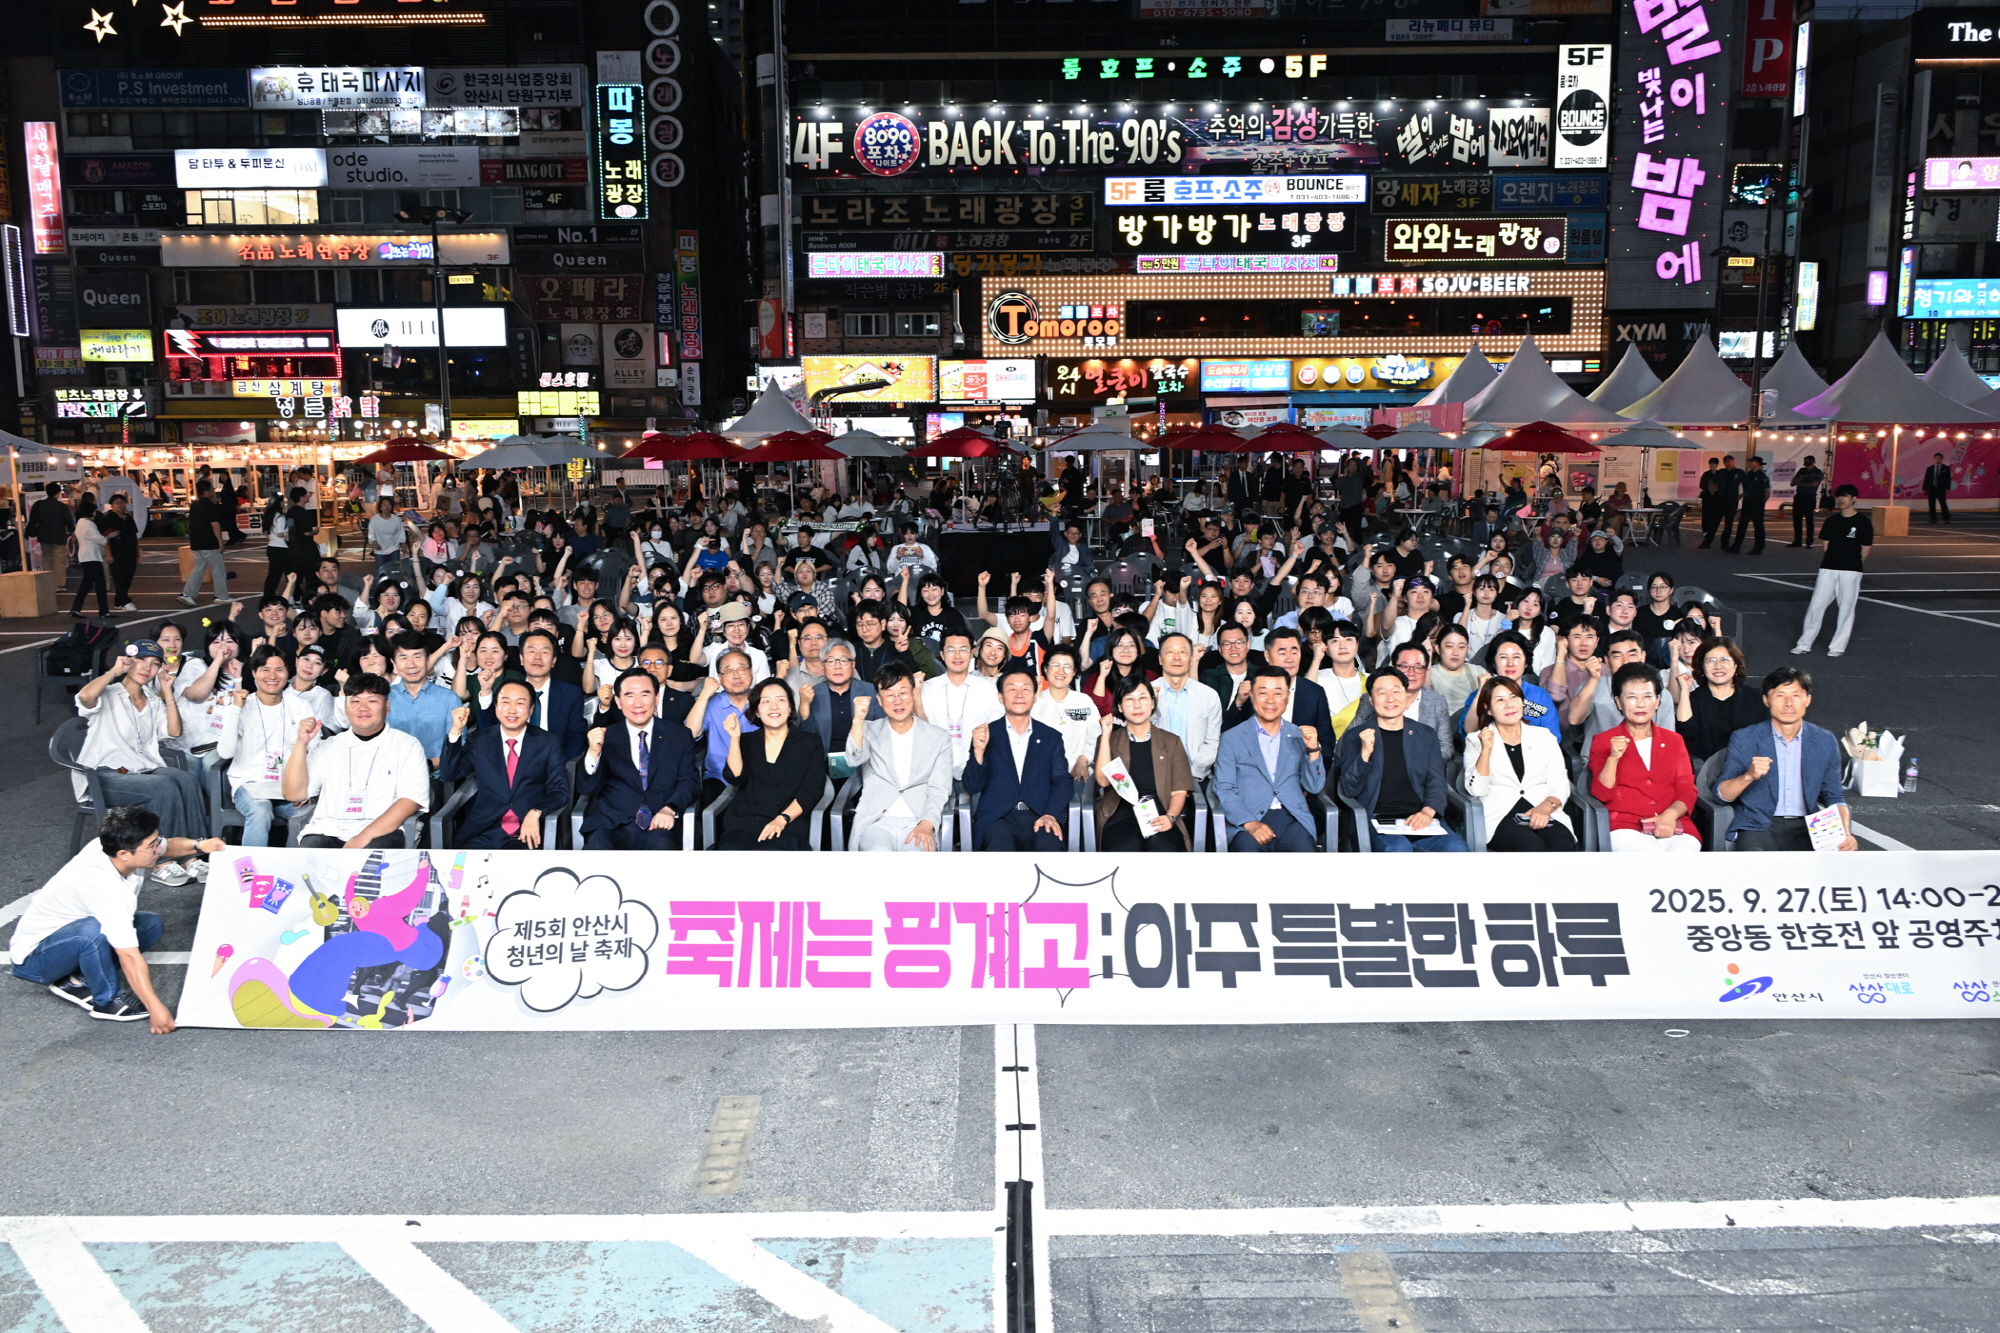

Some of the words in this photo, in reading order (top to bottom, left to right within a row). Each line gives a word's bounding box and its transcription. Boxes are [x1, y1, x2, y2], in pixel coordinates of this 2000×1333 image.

[1153, 8, 1252, 17] 010-6795-5080
[1408, 19, 1464, 33] 리뉴메디
[1468, 19, 1495, 32] 뷰티
[1947, 22, 1992, 42] The
[1567, 47, 1605, 67] 5F
[155, 72, 183, 80] GROUP
[1285, 55, 1327, 79] 5F
[118, 81, 144, 95] P.S
[148, 81, 229, 95] Investment
[297, 71, 315, 93] 휴
[320, 71, 422, 93] 태국마사지
[463, 72, 573, 87] 한국외식업중앙회
[1759, 83, 1787, 94] 노래광장
[464, 89, 503, 104] 안산시
[507, 89, 573, 104] 단원구지부
[1637, 67, 1665, 144] 빛나는
[607, 87, 635, 145] 따봉
[1208, 112, 1266, 140] 추억의
[1271, 107, 1319, 142] 감성
[1319, 111, 1375, 140] 가득한
[1560, 109, 1605, 128] BOUNCE
[864, 126, 911, 146] 8090
[928, 120, 1018, 167] BACK
[1023, 119, 1057, 166] To
[1062, 119, 1115, 164] The
[1122, 116, 1182, 165] 90's
[794, 122, 844, 171] 4F
[866, 145, 900, 160] 포차
[111, 162, 152, 170] AMAZON
[188, 158, 199, 170] 담
[202, 158, 224, 170] 타투
[228, 158, 237, 170] &
[240, 158, 285, 170] 두피문신
[333, 152, 368, 167] ode
[875, 159, 898, 168] 나이트
[1251, 151, 1331, 173] 소주+호프
[31, 128, 59, 227] 생활맥주
[346, 167, 409, 184] studio.
[505, 163, 537, 179] HANG
[539, 163, 564, 178] OUT
[604, 159, 643, 180] 노래
[547, 193, 563, 204] 4F
[604, 183, 645, 204] 광장
[1110, 181, 1138, 201] 5F
[1144, 178, 1166, 203] 룸
[1173, 179, 1264, 201] 호프·소주
[1286, 178, 1345, 191] BOUNCE
[1374, 180, 1441, 208] 왕세자
[1441, 179, 1491, 194] 노래광장
[1501, 181, 1554, 204] 오렌지
[1556, 181, 1599, 194] 노래광장
[810, 196, 912, 227] 노라조
[922, 194, 1060, 228] 노래광장
[1456, 196, 1482, 208] 3F
[71, 233, 107, 243] 크레이지
[557, 227, 598, 244] No.1
[1118, 213, 1252, 248] 방가방가
[1257, 211, 1346, 234] 노래광장
[1569, 229, 1603, 245] 원룸텔
[807, 242, 837, 250] Business
[892, 233, 930, 251] 허니
[955, 234, 1011, 248] 노래광장
[1068, 233, 1091, 247] 2F
[1291, 234, 1312, 248] 3F
[99, 252, 137, 263] Queen
[238, 243, 275, 261] 名品
[278, 242, 371, 262] 노래연습장
[552, 252, 607, 268] Queen
[678, 235, 698, 274] 따봉
[812, 254, 930, 275] 콘타이태국마사지
[1153, 257, 1180, 270] 5만원
[1183, 256, 1320, 271] 콘타이태국마사지
[35, 265, 51, 304] BAR
[538, 277, 629, 302] 오페라
[844, 282, 889, 300] 작은별
[895, 282, 925, 299] 공간
[933, 281, 949, 294] 2F
[1421, 276, 1530, 293] SOJU·BEER
[83, 288, 142, 307] Queen
[1914, 288, 1975, 309] 청기와
[196, 308, 228, 326] 조아
[229, 307, 293, 325] 노래광장
[548, 305, 611, 321] 노래광장
[615, 307, 632, 320] 3F
[680, 281, 700, 348] 노래광장
[999, 304, 1121, 339] Tomoroo
[100, 332, 122, 343] Live
[123, 332, 147, 343] Cafe
[1616, 322, 1668, 343] XYM
[92, 345, 142, 359] 해바라기
[614, 361, 647, 370] HUTONG
[614, 369, 647, 380] ALLEY
[1206, 365, 1248, 376] 도심속에서
[1251, 363, 1288, 377] 싱싱한
[237, 381, 261, 393] 금산
[268, 381, 326, 397] 삼계탕
[1085, 366, 1149, 396] 얼큰이
[1149, 364, 1189, 381] 칼국수
[1157, 380, 1186, 395] 포차
[54, 389, 131, 402] 벤츠노래광장
[276, 397, 381, 418] 정든닭발
[1649, 888, 1734, 914] 2025.
[1742, 888, 1767, 914] 9.
[1776, 886, 1868, 915] 27.(토)
[513, 919, 566, 942] 제5회
[571, 912, 630, 939] 안산시
[1686, 923, 1773, 952] 중앙동
[1776, 920, 1867, 951] 한호전
[1871, 918, 1901, 950] 앞
[505, 942, 566, 969] 청년의
[569, 940, 590, 964] 날
[593, 937, 634, 962] 축제
[665, 900, 873, 990] 축제는
[1121, 900, 1261, 990] 아주
[1268, 900, 1477, 990] 특별한
[1484, 900, 1632, 990] 하루
[1771, 991, 1825, 1003] 안산시
